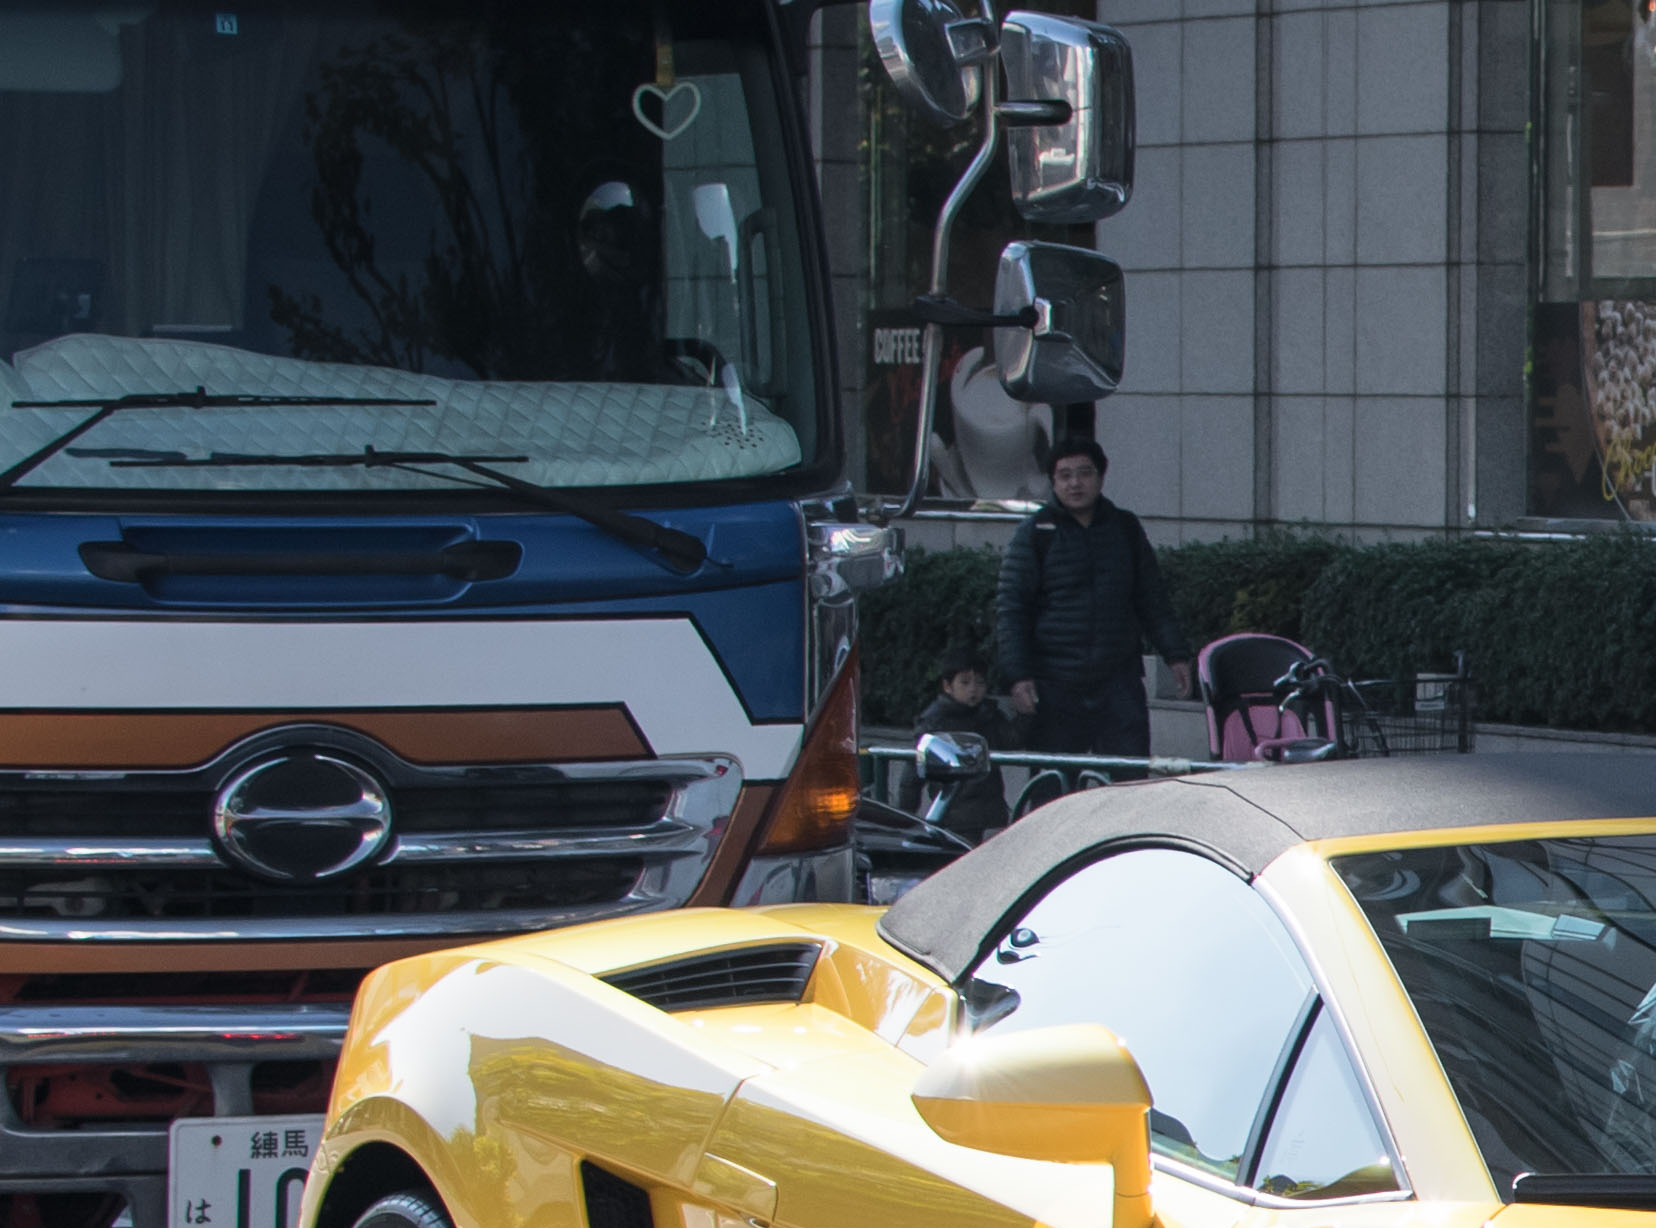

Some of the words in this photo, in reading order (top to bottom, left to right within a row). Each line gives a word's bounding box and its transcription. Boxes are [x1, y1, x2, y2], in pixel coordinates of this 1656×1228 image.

[873, 327, 921, 365] COFFEE
[250, 1130, 309, 1159] 練馬
[185, 1198, 212, 1225] は
